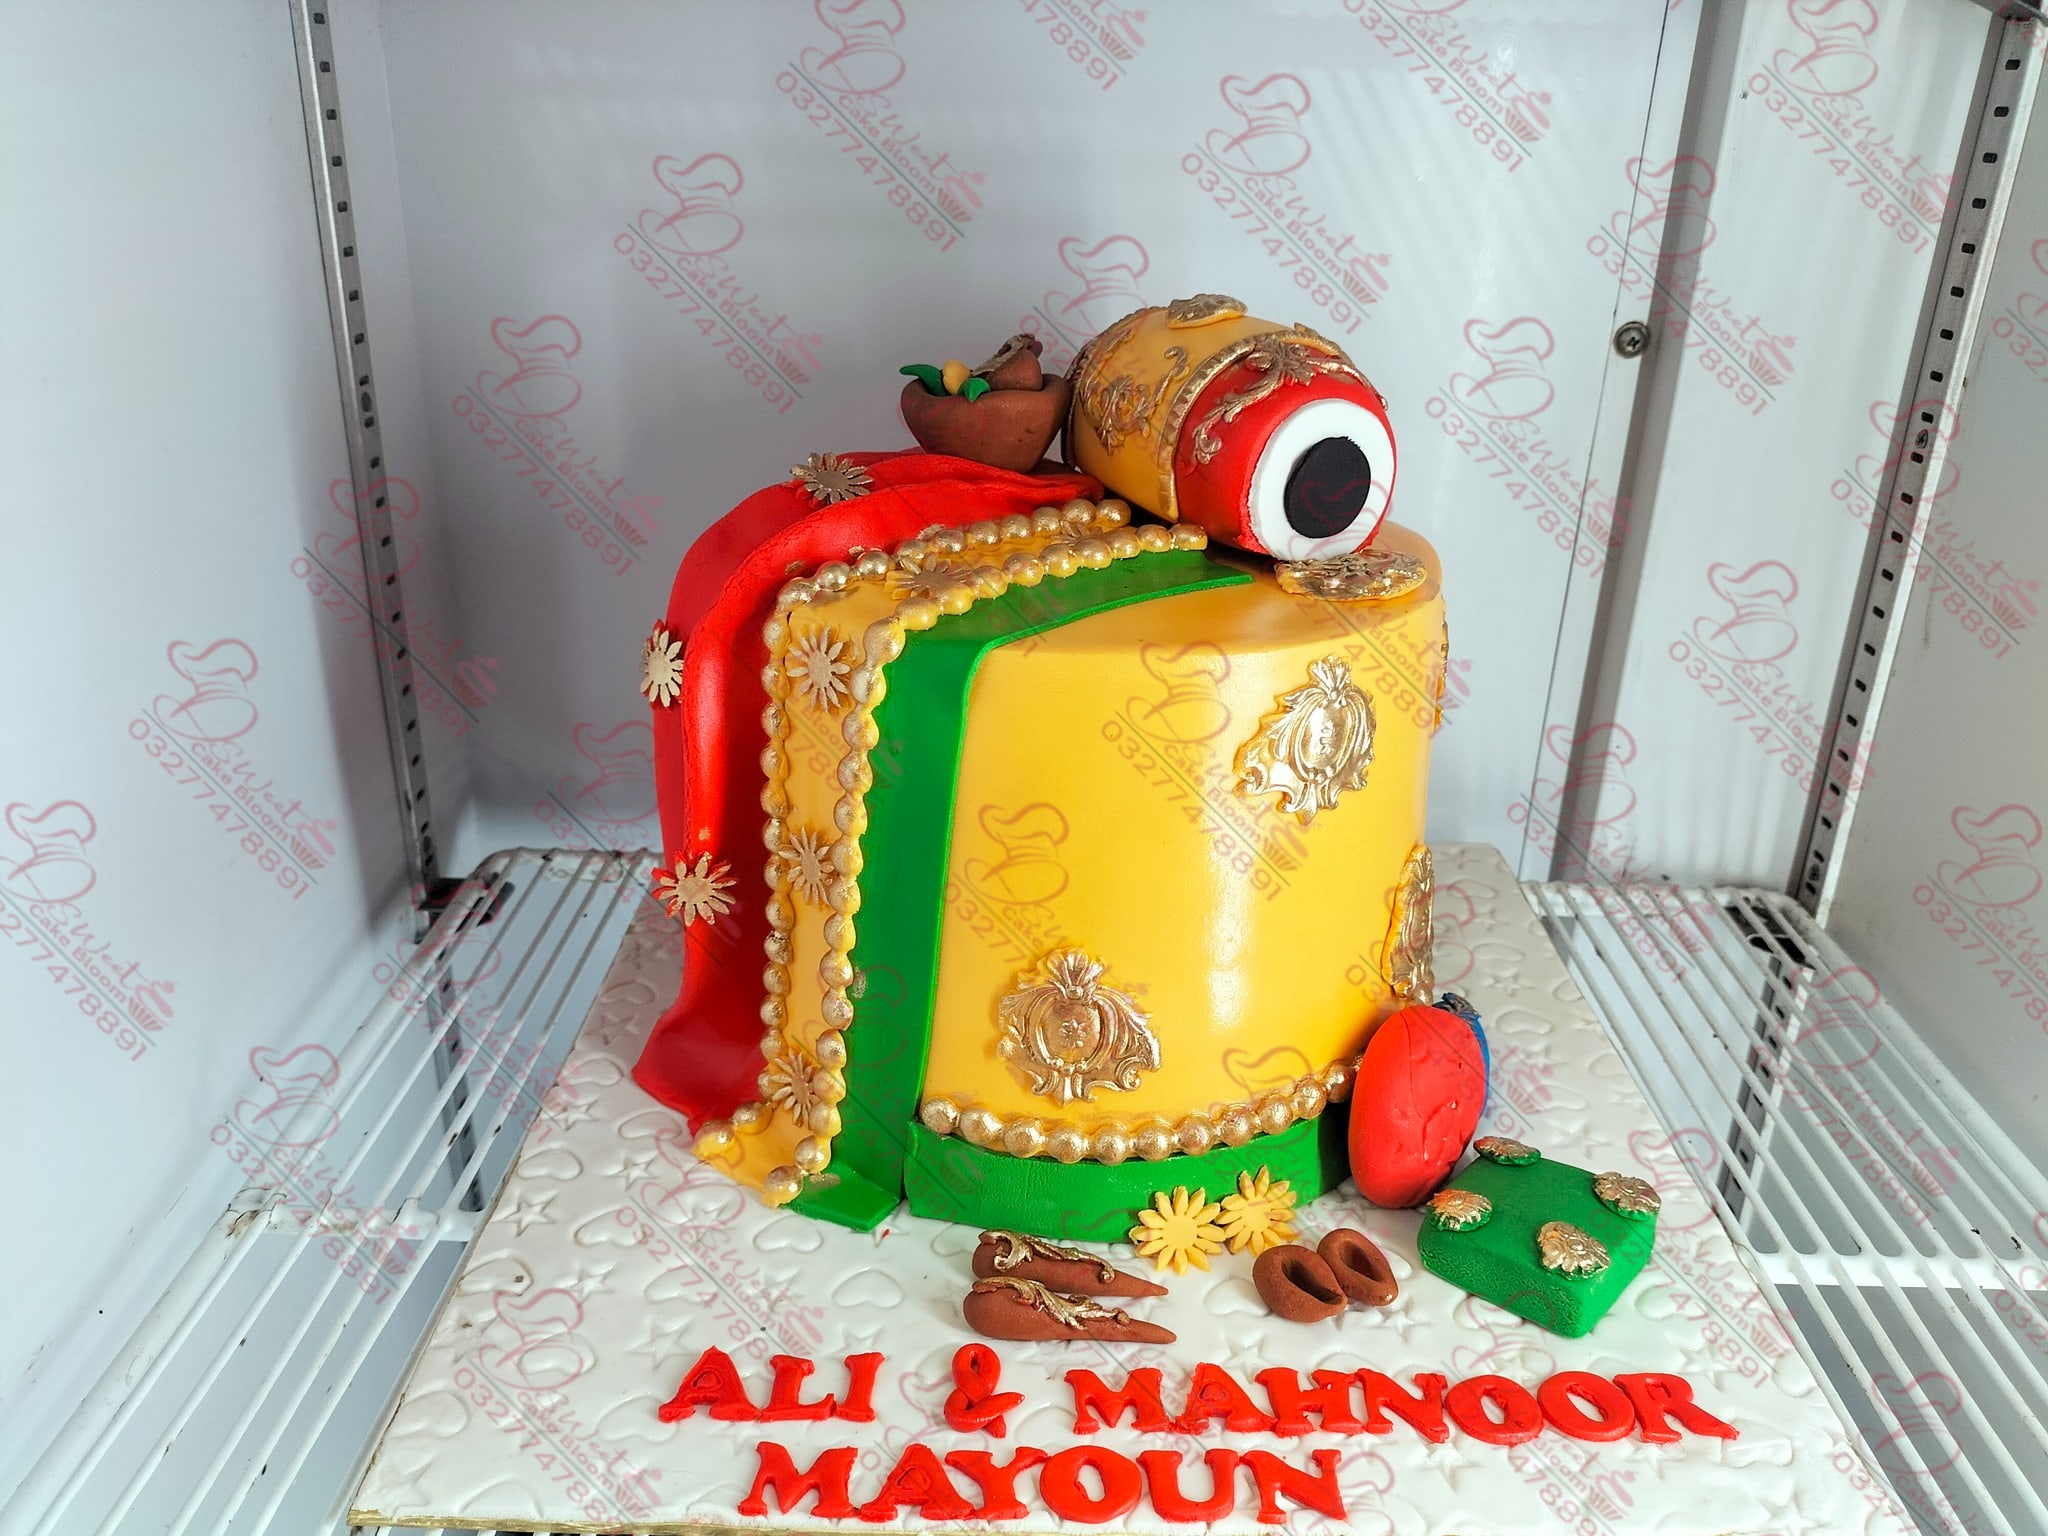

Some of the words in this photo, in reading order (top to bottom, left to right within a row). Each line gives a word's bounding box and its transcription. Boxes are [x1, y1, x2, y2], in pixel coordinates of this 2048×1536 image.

[658, 1345, 884, 1423] ALI
[944, 1343, 1026, 1438] &
[1065, 1362, 1740, 1446] MAHNOOR
[738, 1441, 1347, 1524] MAYOUN
